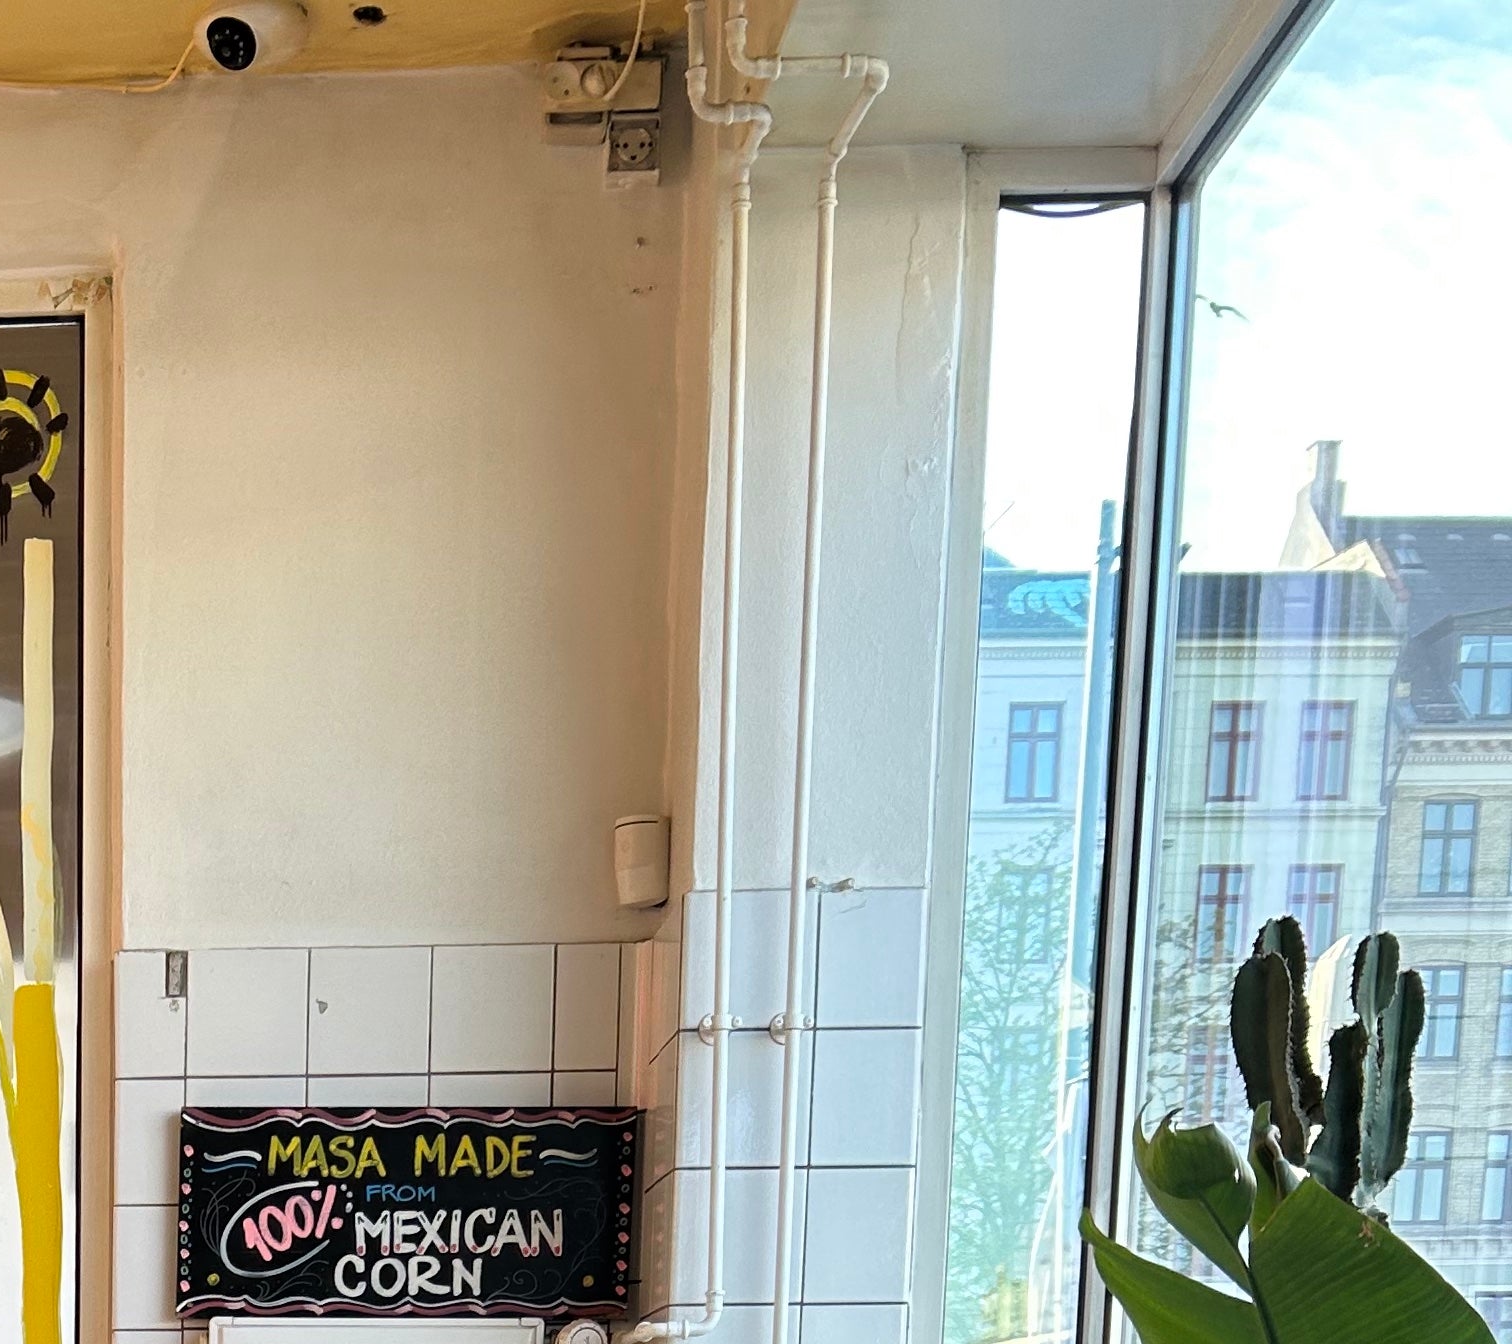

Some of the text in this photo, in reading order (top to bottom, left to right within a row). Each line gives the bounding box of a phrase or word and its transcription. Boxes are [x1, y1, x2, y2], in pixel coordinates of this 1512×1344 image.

[268, 1133, 537, 1179] MASA MADE
[365, 1183, 436, 1203] FROM
[242, 1184, 344, 1261] 100%
[354, 1207, 564, 1258] MEXICAN
[333, 1254, 484, 1298] CORN
